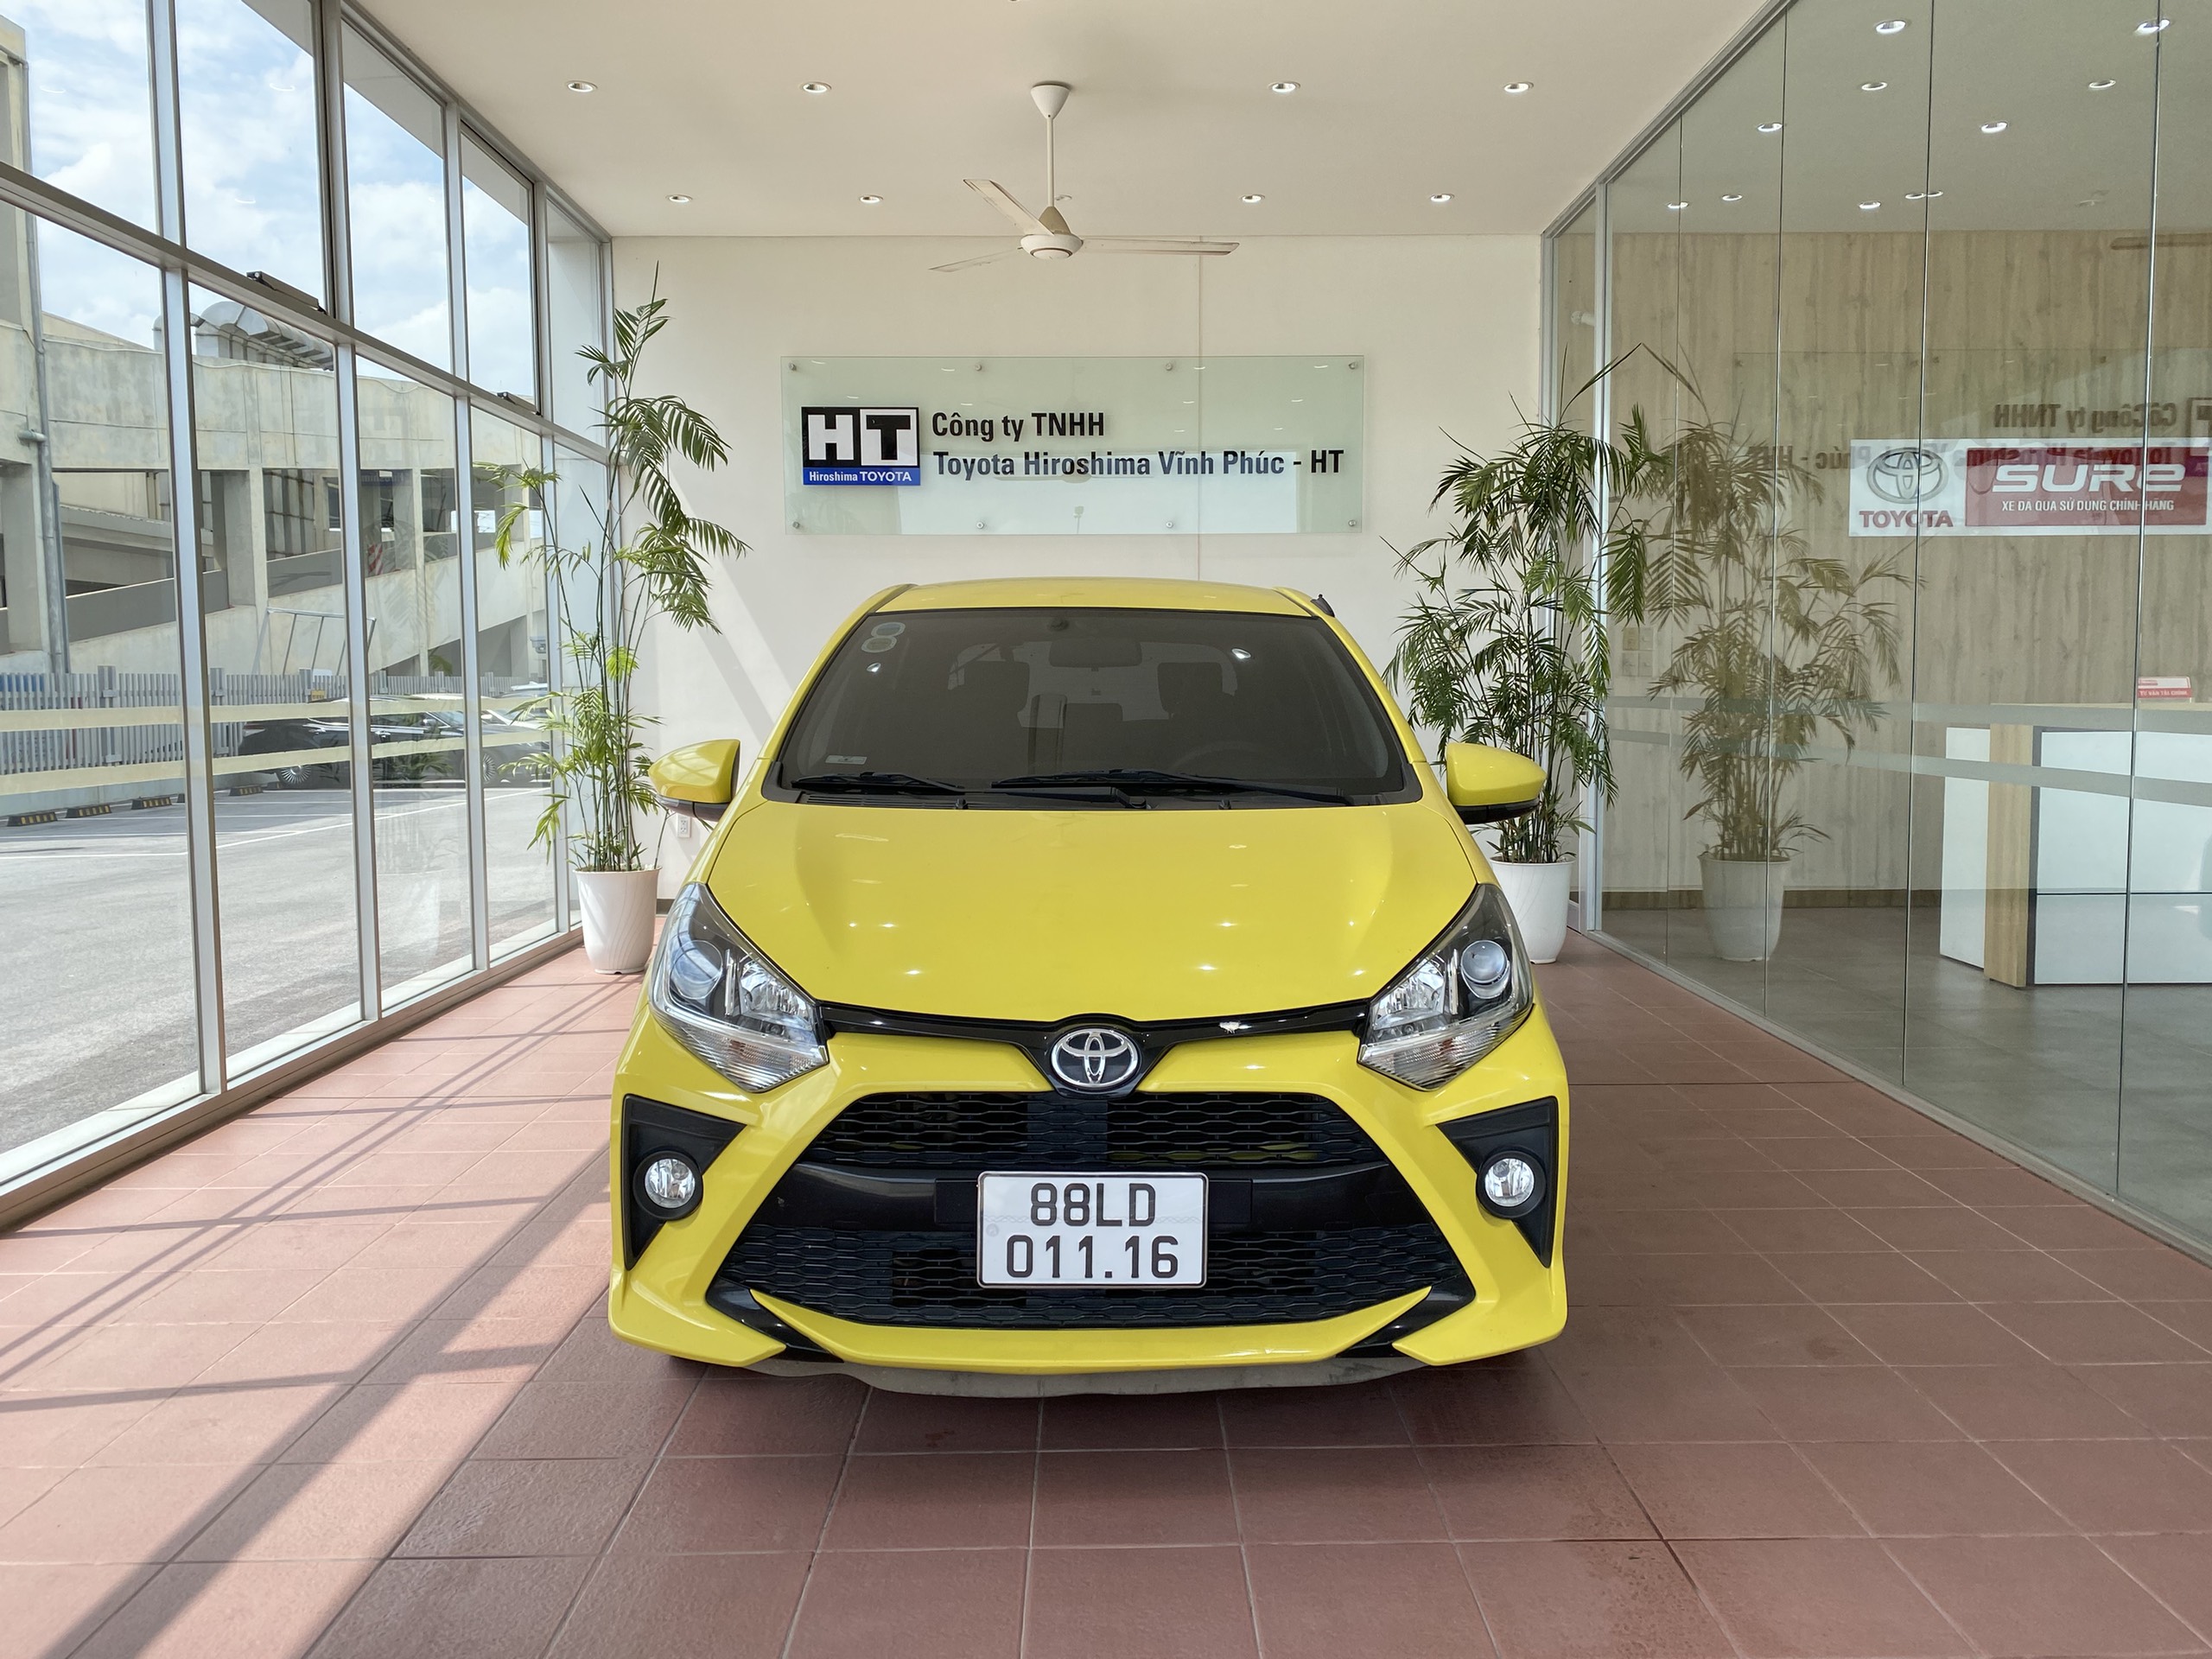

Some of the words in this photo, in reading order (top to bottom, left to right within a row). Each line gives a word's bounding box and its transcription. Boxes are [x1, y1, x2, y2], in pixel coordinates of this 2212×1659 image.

[808, 414, 912, 461] HT
[931, 412, 994, 442] Công
[1001, 416, 1025, 442] ty
[1032, 412, 1104, 436] TNHH
[809, 471, 858, 481] Hiroshima
[859, 471, 912, 481] TOYOTA
[932, 451, 1014, 480] Toyota
[1024, 451, 1150, 475] Hiroshima
[1158, 450, 1214, 474] Vĩnh
[1223, 450, 1285, 474] Phúc
[1311, 449, 1344, 474] HT
[1859, 510, 1954, 528] TOYOTA
[2002, 500, 2015, 512] XE
[2035, 500, 2056, 512] QUA
[1031, 1183, 1155, 1227] 88LD
[1007, 1235, 1178, 1278] 011.16
